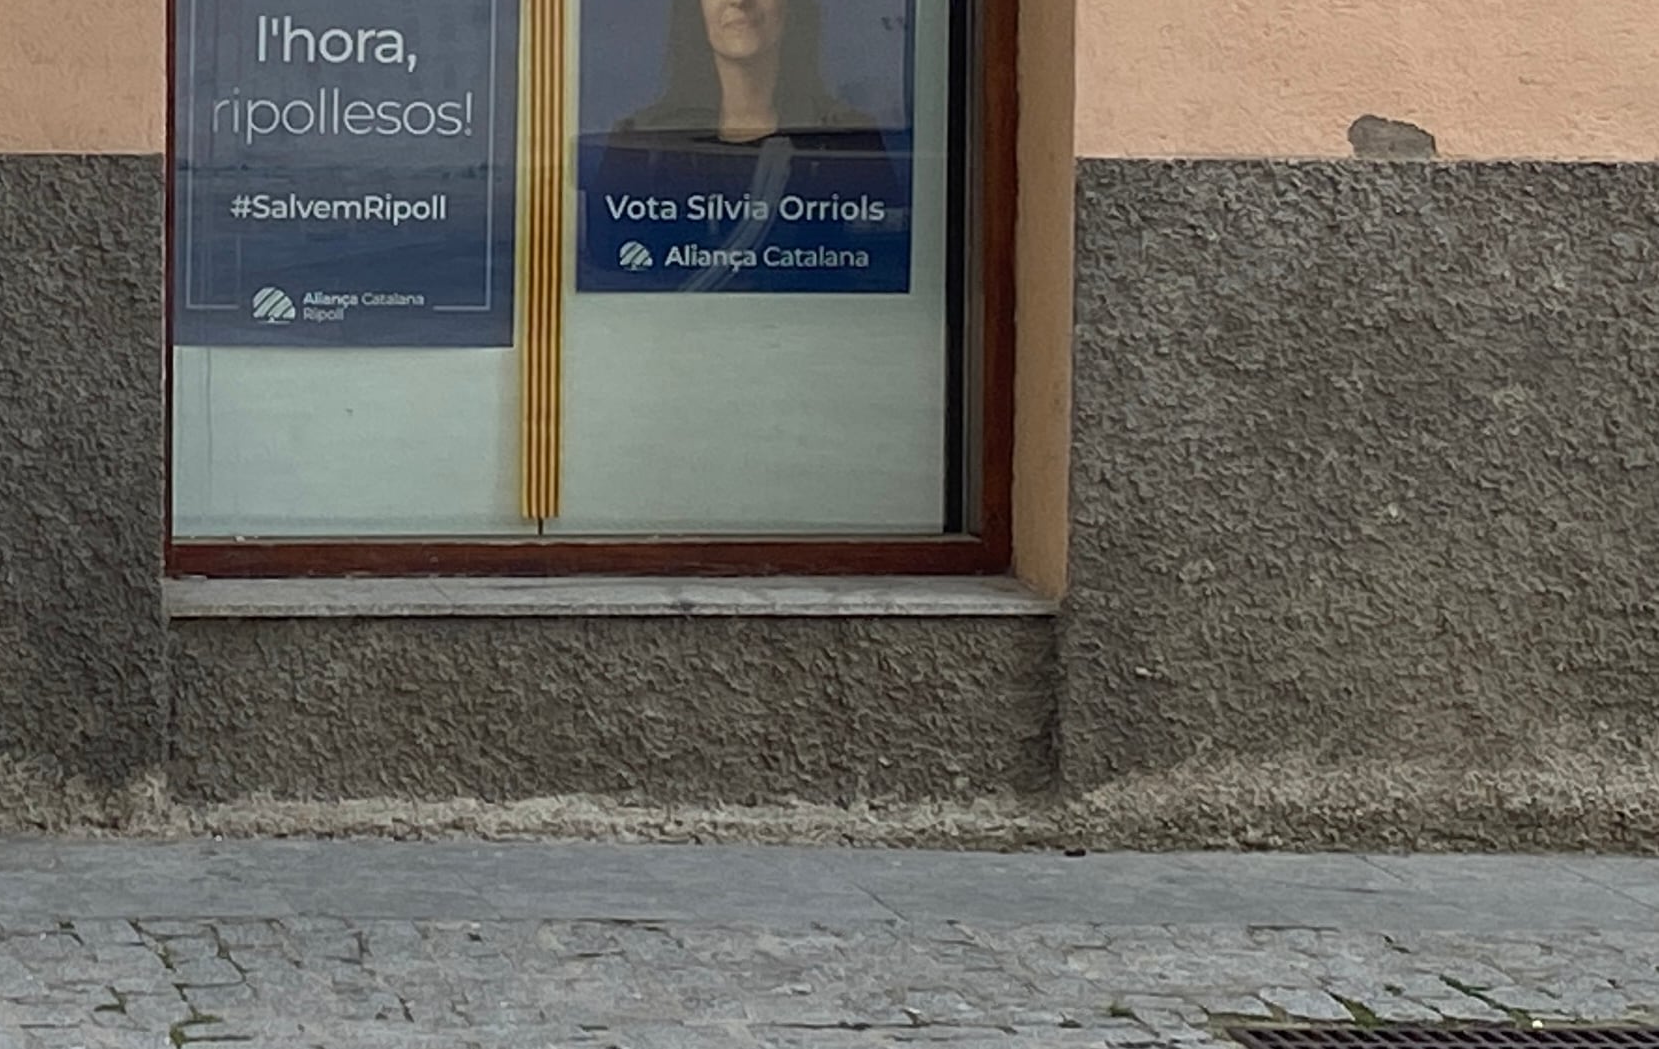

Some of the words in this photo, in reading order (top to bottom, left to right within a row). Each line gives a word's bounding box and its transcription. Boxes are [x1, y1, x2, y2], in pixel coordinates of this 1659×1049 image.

[257, 15, 417, 72] l'hora,
[213, 86, 474, 145] ripollesos!
[230, 194, 446, 226] #SalvemRipoll
[606, 195, 677, 220] Vota
[779, 193, 885, 221] Orriols
[664, 244, 757, 272] Aliança
[763, 246, 869, 267] Catalana
[303, 292, 358, 308] Aliança
[361, 292, 425, 305] Catalana
[303, 308, 344, 321] Ripoll
